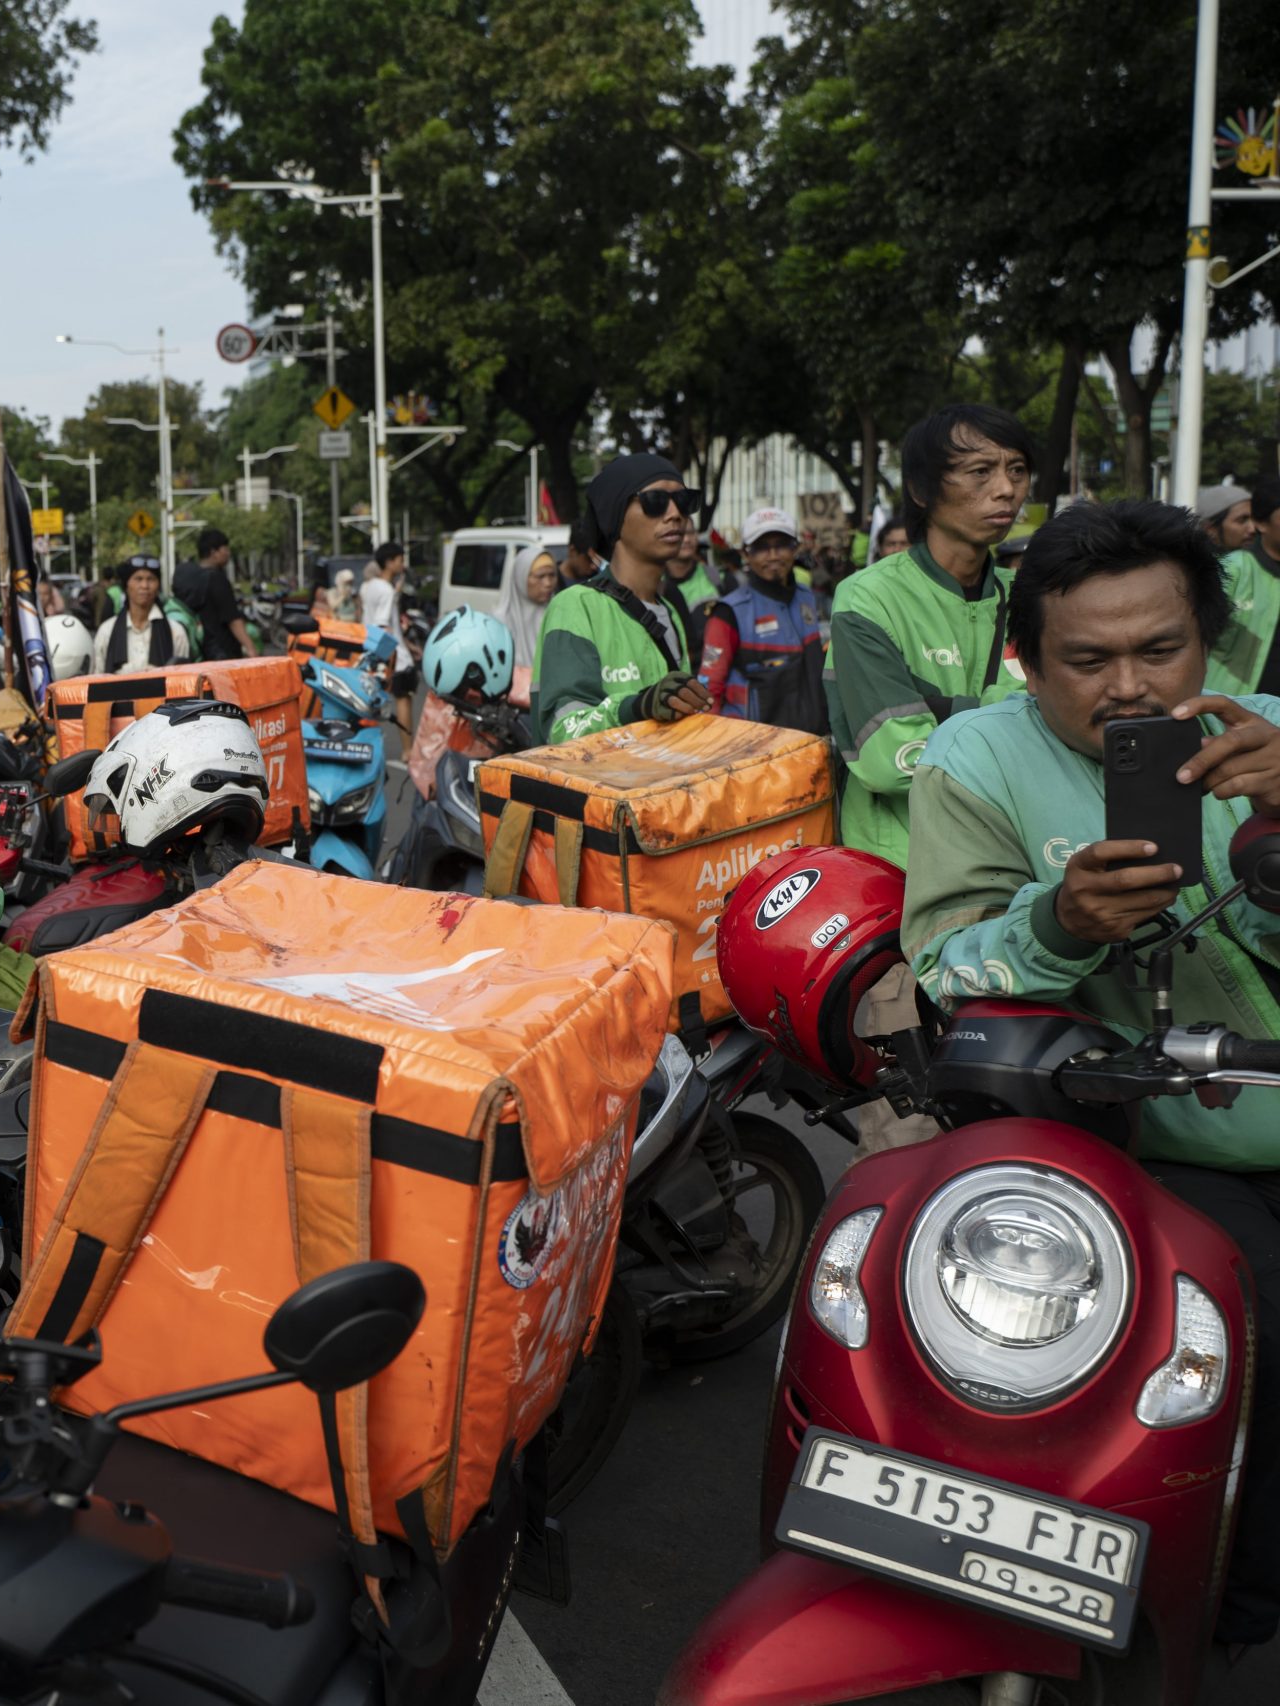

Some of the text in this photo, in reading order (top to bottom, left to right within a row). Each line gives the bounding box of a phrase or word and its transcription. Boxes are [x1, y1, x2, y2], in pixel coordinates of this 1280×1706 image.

[602, 661, 640, 683] Grab
[133, 752, 176, 811] NHK
[769, 878, 802, 913] Kyt
[816, 917, 845, 945] DOT
[943, 1031, 988, 1042] ONDA
[816, 1449, 1122, 1576] F 5153 FIR
